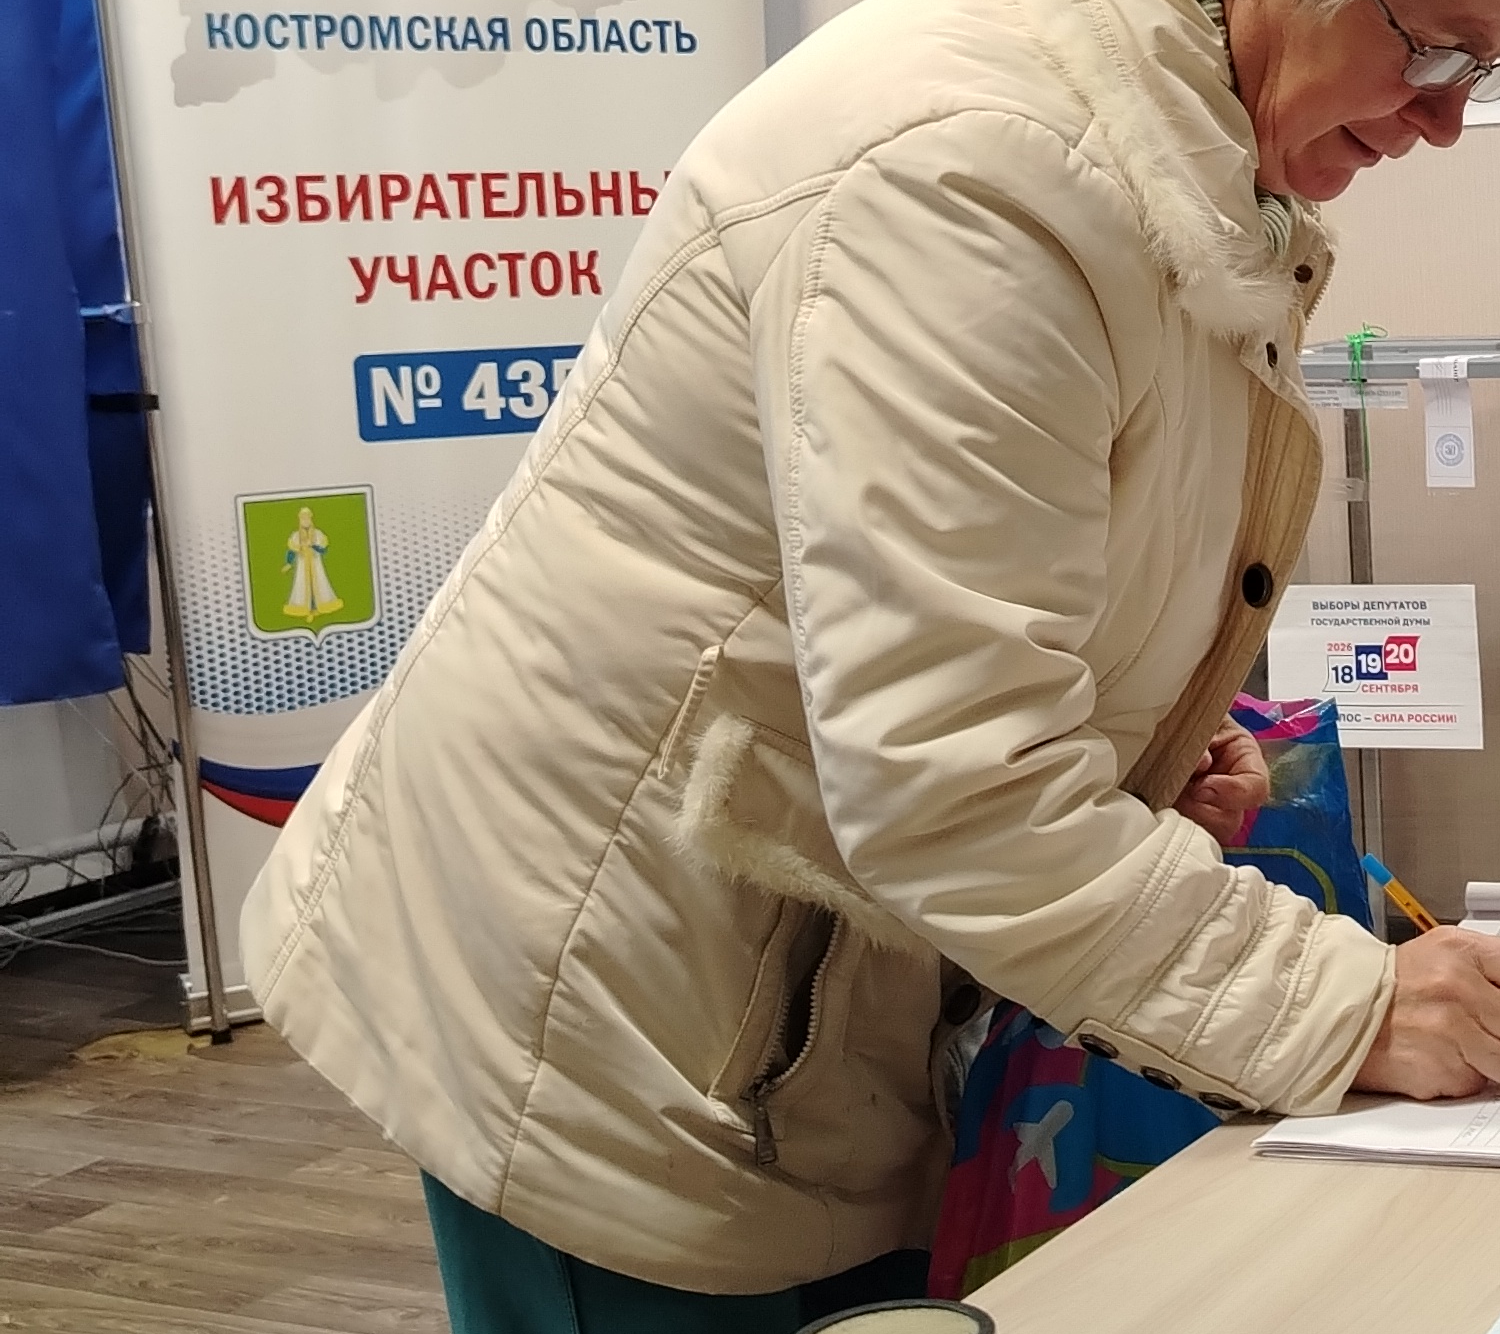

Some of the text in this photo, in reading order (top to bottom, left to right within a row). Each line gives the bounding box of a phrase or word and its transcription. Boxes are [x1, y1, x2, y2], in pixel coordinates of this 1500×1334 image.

[205, 13, 698, 55] КОСТРОМСКАЯ ОБЛАСТЬ
[348, 248, 603, 306] УЧАСТОК
[371, 364, 442, 427] №
[1312, 601, 1427, 612] ВЫБОРЫ ДЕПУТАТОВ
[1311, 616, 1430, 627] ГОСУДАРСТВЕННОЙ ДУМЫ
[1327, 643, 1381, 674] 2026 19
[1386, 644, 1414, 664] 20
[1332, 665, 1353, 683] 18
[1361, 684, 1419, 693] СЕНТЯБРЯ
[1374, 713, 1405, 722] СИЛА
[1408, 714, 1457, 723] РОССИИ!
